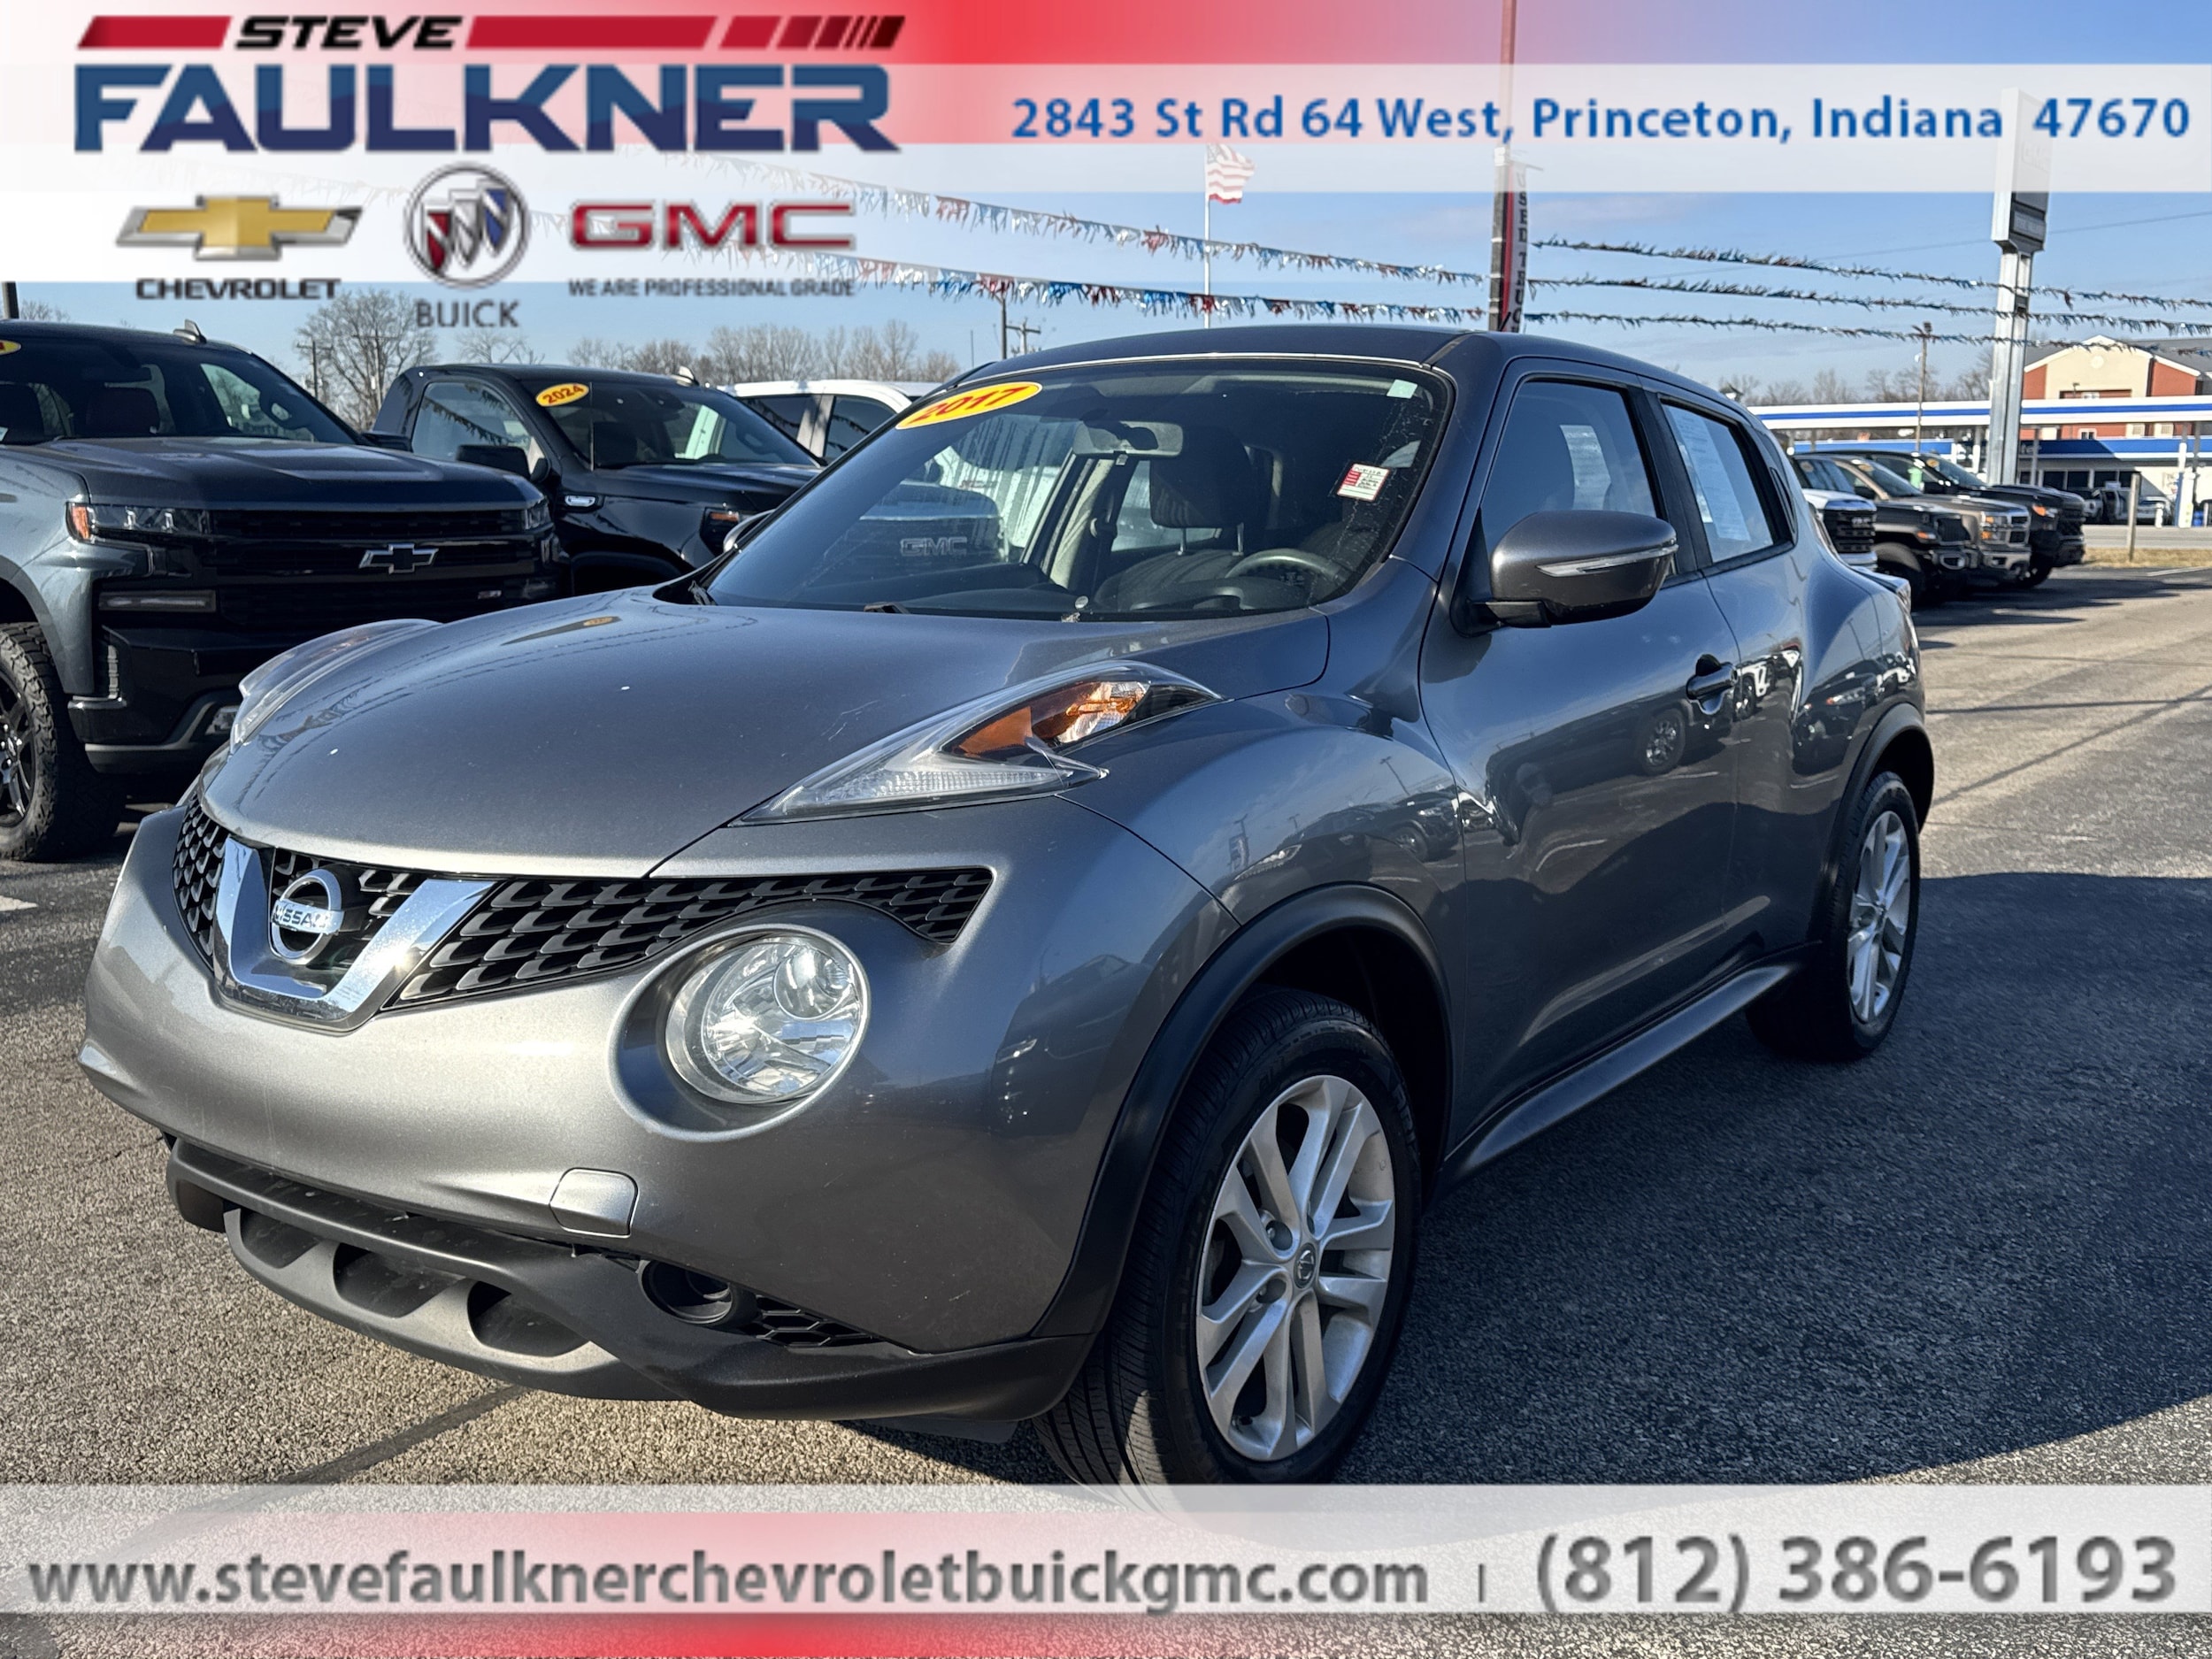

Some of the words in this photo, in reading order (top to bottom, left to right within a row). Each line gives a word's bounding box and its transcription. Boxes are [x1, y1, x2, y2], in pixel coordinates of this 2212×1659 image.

[542, 383, 585, 404] 2024
[906, 386, 1029, 425] 2017
[900, 536, 968, 557] GMC
